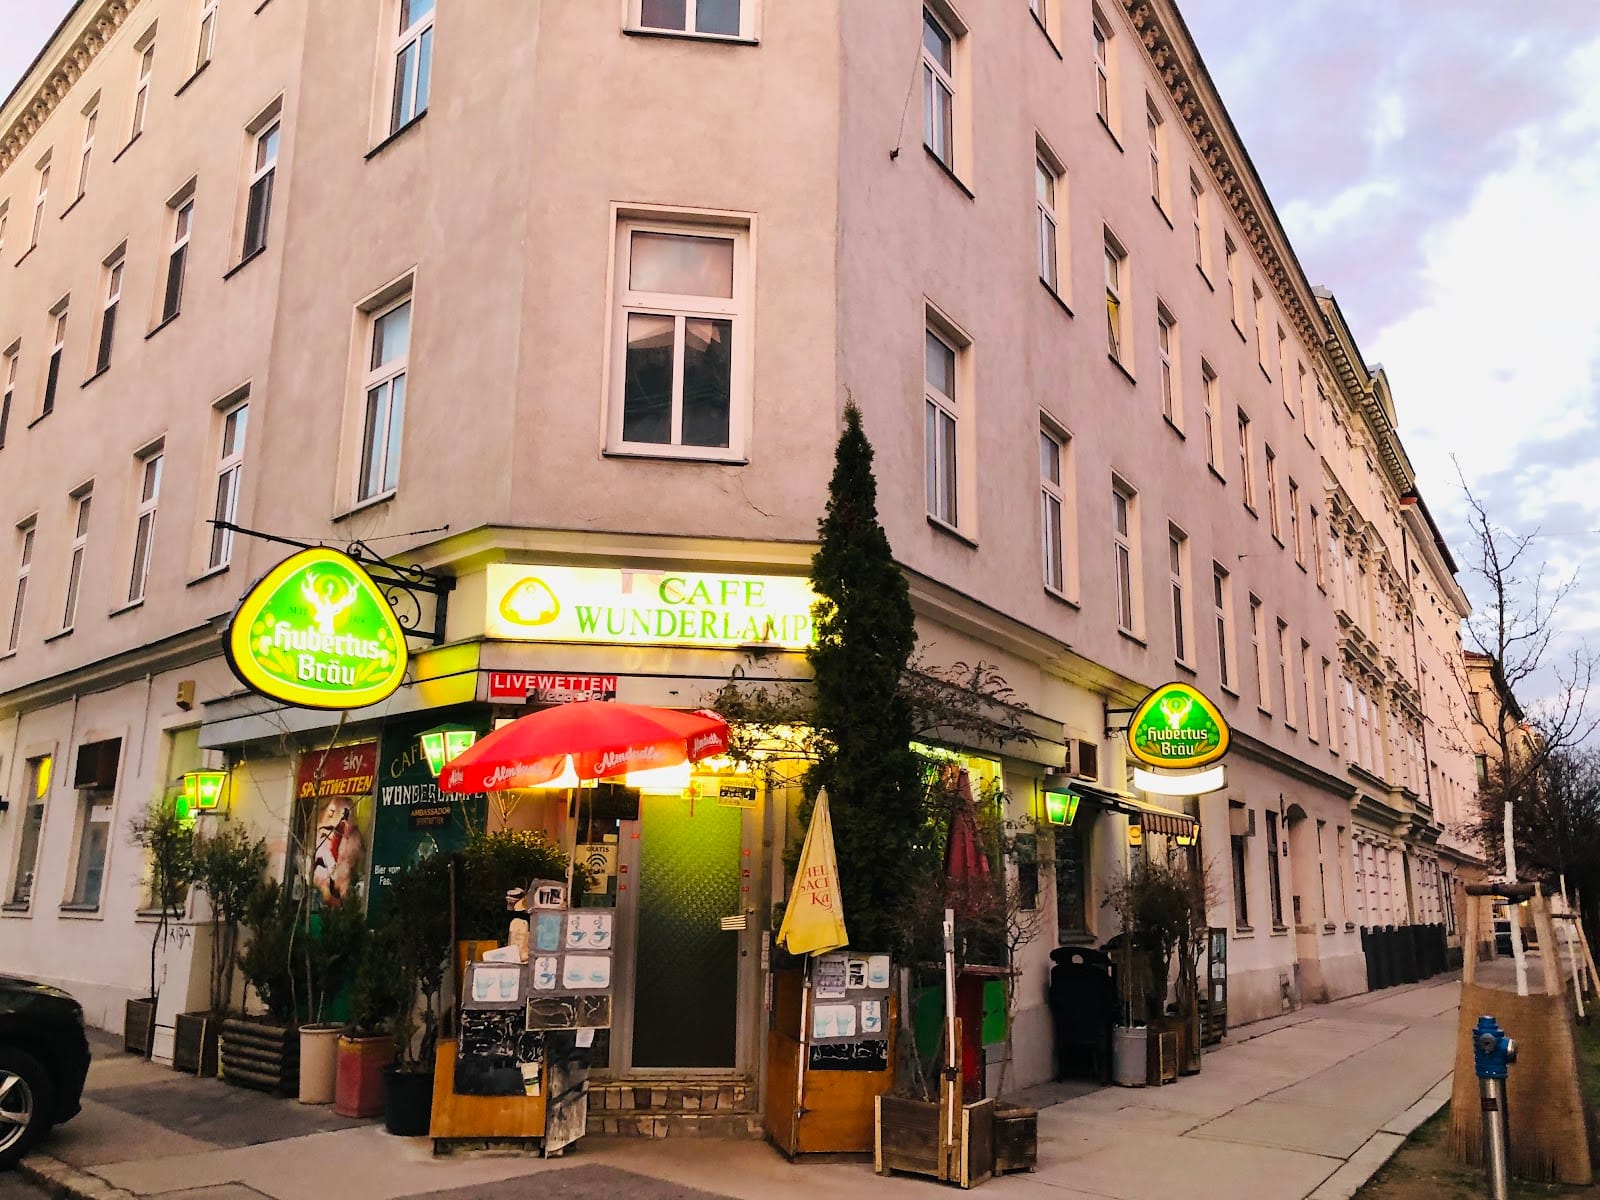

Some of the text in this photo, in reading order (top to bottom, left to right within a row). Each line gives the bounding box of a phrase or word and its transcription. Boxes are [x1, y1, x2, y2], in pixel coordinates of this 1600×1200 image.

[658, 577, 767, 608] CAFE
[273, 620, 380, 660] Hubertus
[297, 654, 356, 686] Bräu
[494, 674, 615, 692] LIVEWETTEN
[1147, 727, 1208, 742] Hubertus
[1161, 741, 1195, 756] Bräu
[343, 751, 363, 774] sky
[593, 746, 665, 775] Almdudl
[483, 762, 552, 788] Almdu
[381, 783, 483, 806] WUNDERL
[374, 864, 387, 875] Bier
